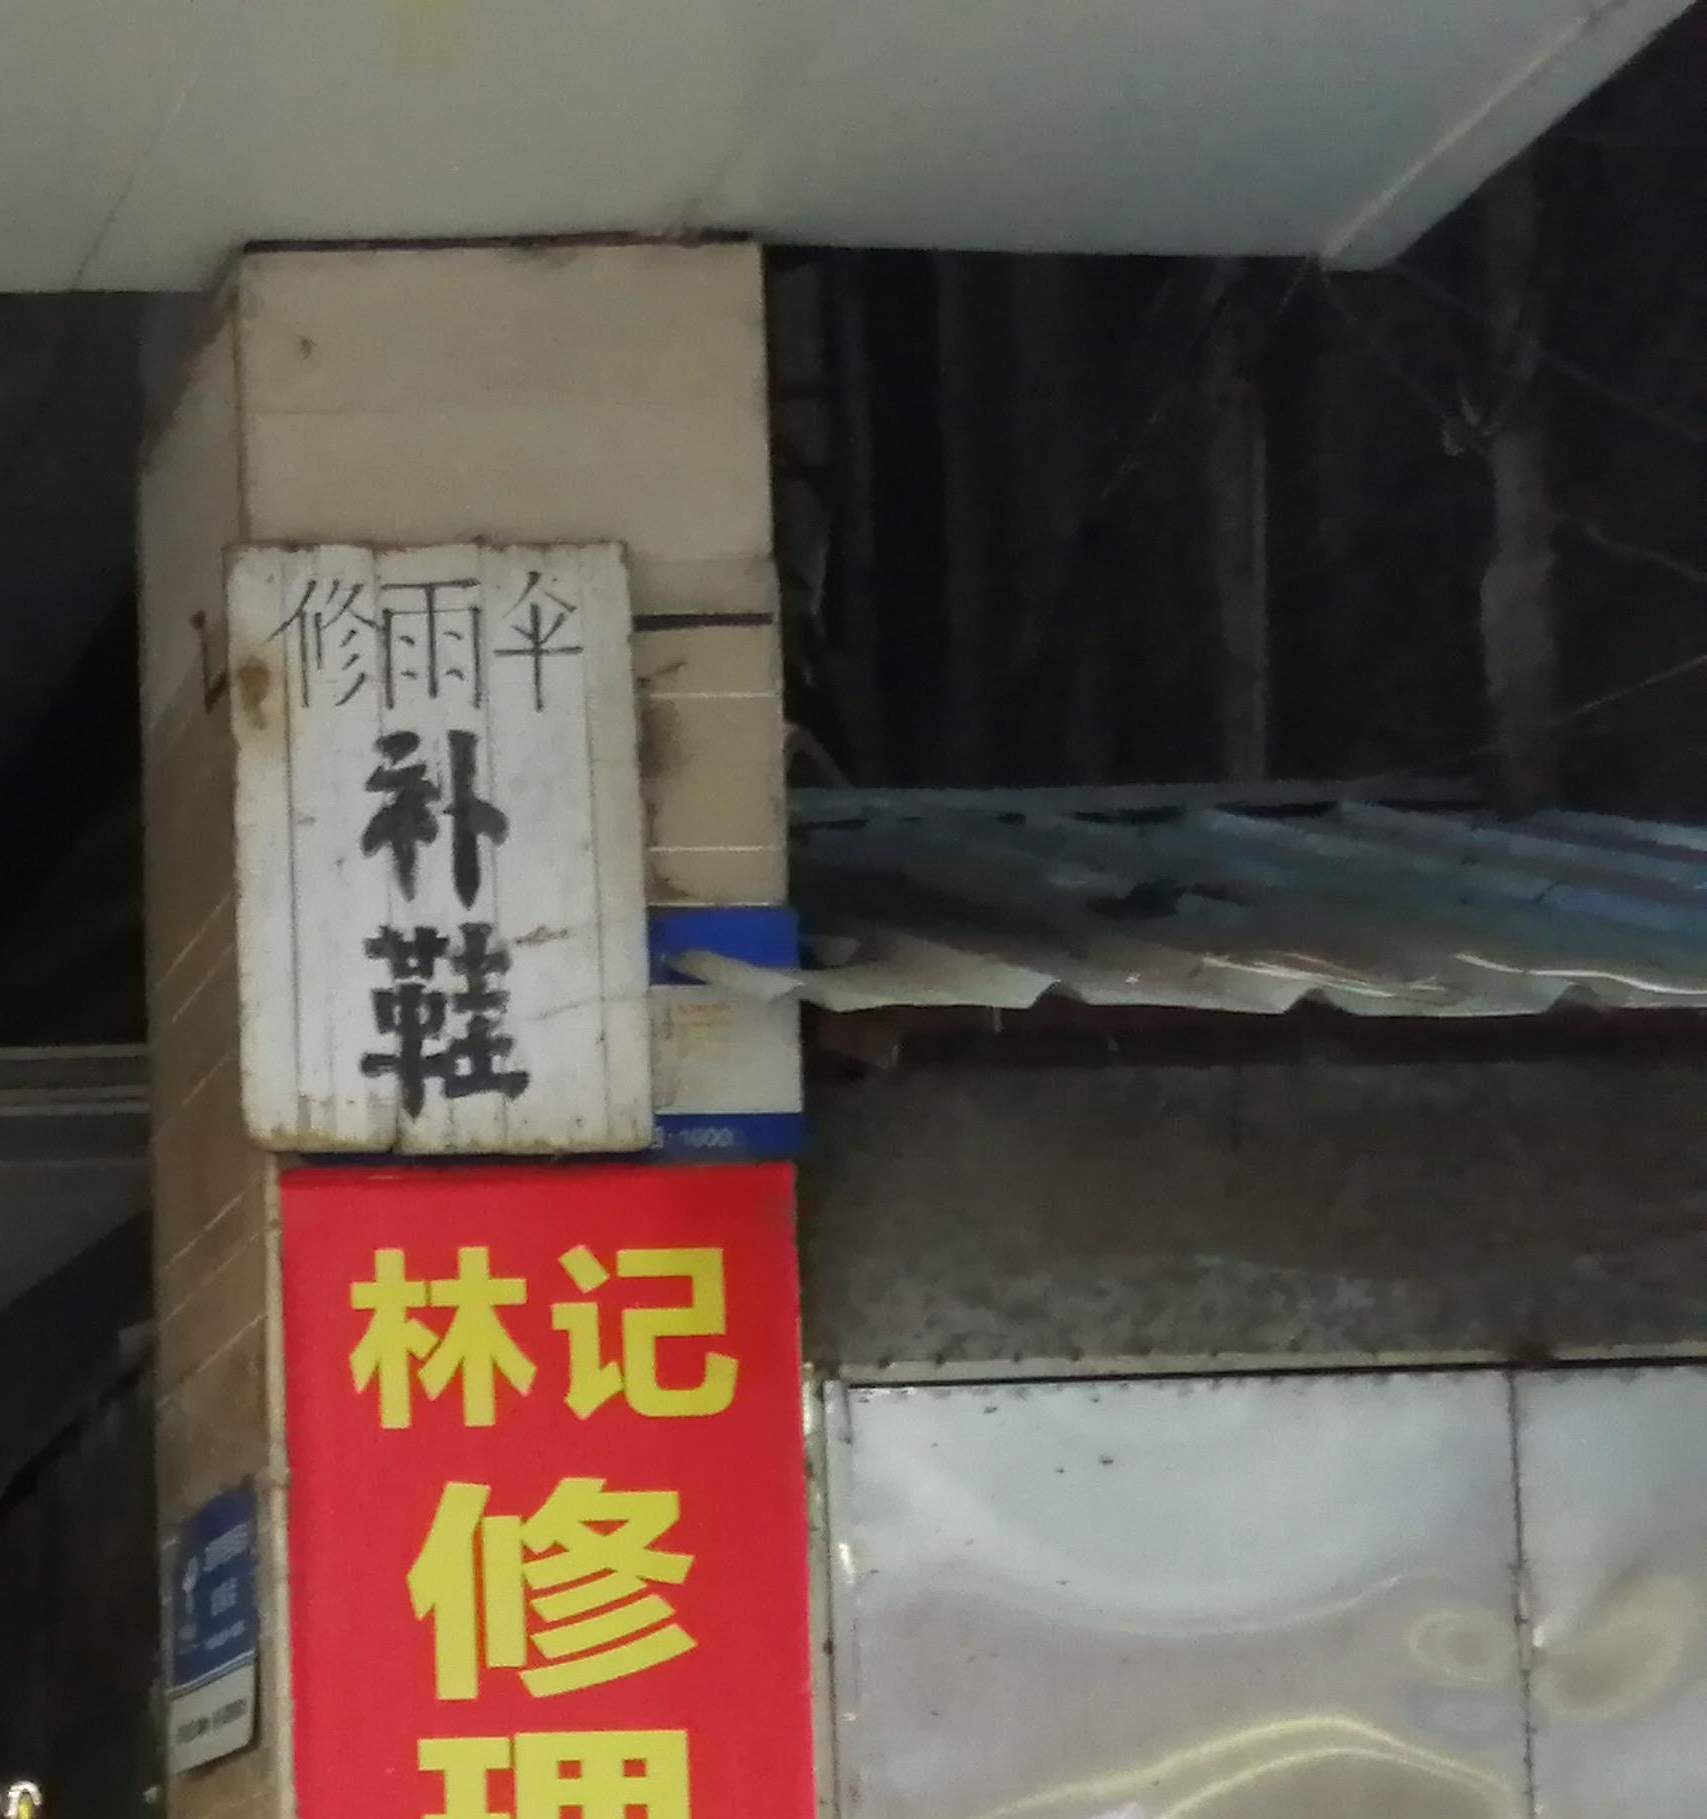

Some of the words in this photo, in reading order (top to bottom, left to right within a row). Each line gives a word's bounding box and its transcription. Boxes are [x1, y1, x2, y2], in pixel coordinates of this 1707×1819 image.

[265, 570, 585, 712] 修雨伞
[360, 729, 530, 1119] 补鞋
[349, 1243, 740, 1430] 林记
